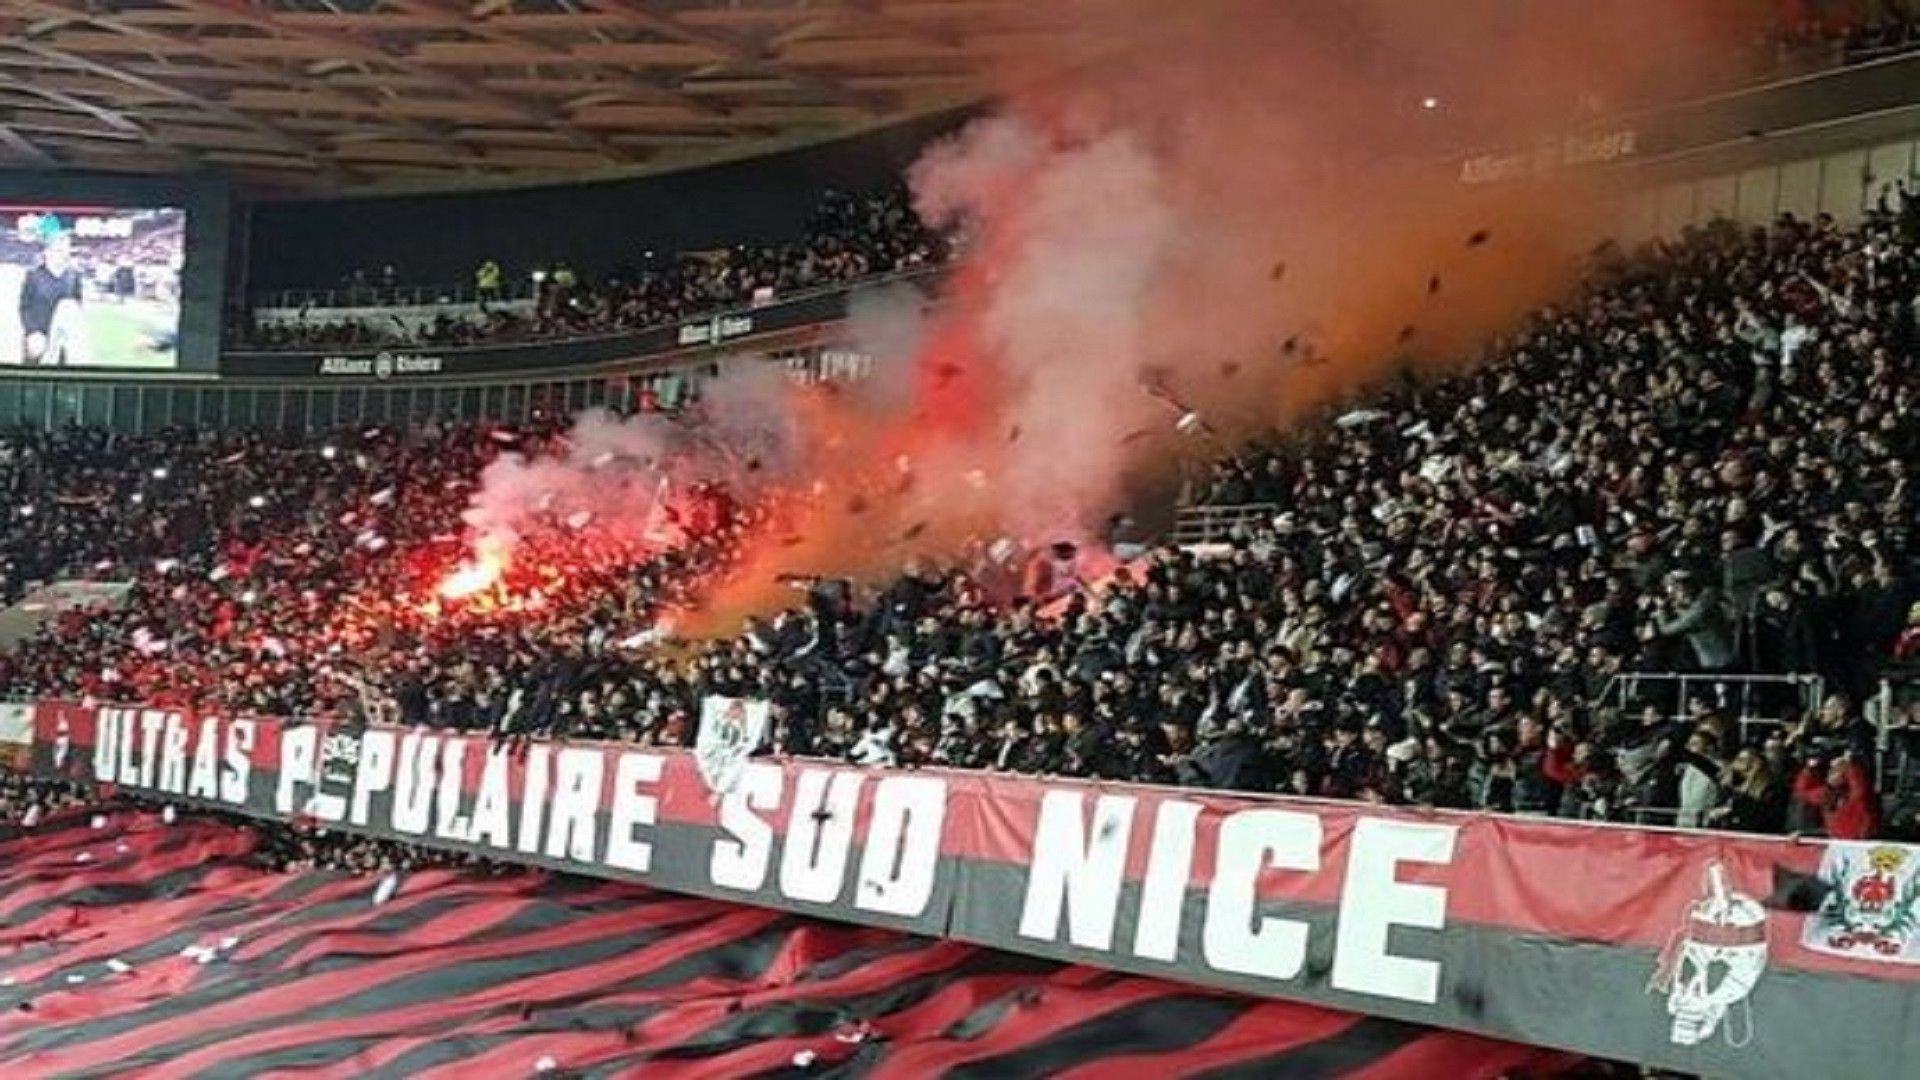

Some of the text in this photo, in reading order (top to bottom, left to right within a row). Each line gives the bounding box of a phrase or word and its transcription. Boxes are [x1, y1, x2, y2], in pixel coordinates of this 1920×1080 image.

[94, 707, 252, 803] ULTRAS
[710, 765, 948, 917] SUD
[1018, 790, 1460, 1004] NICE
